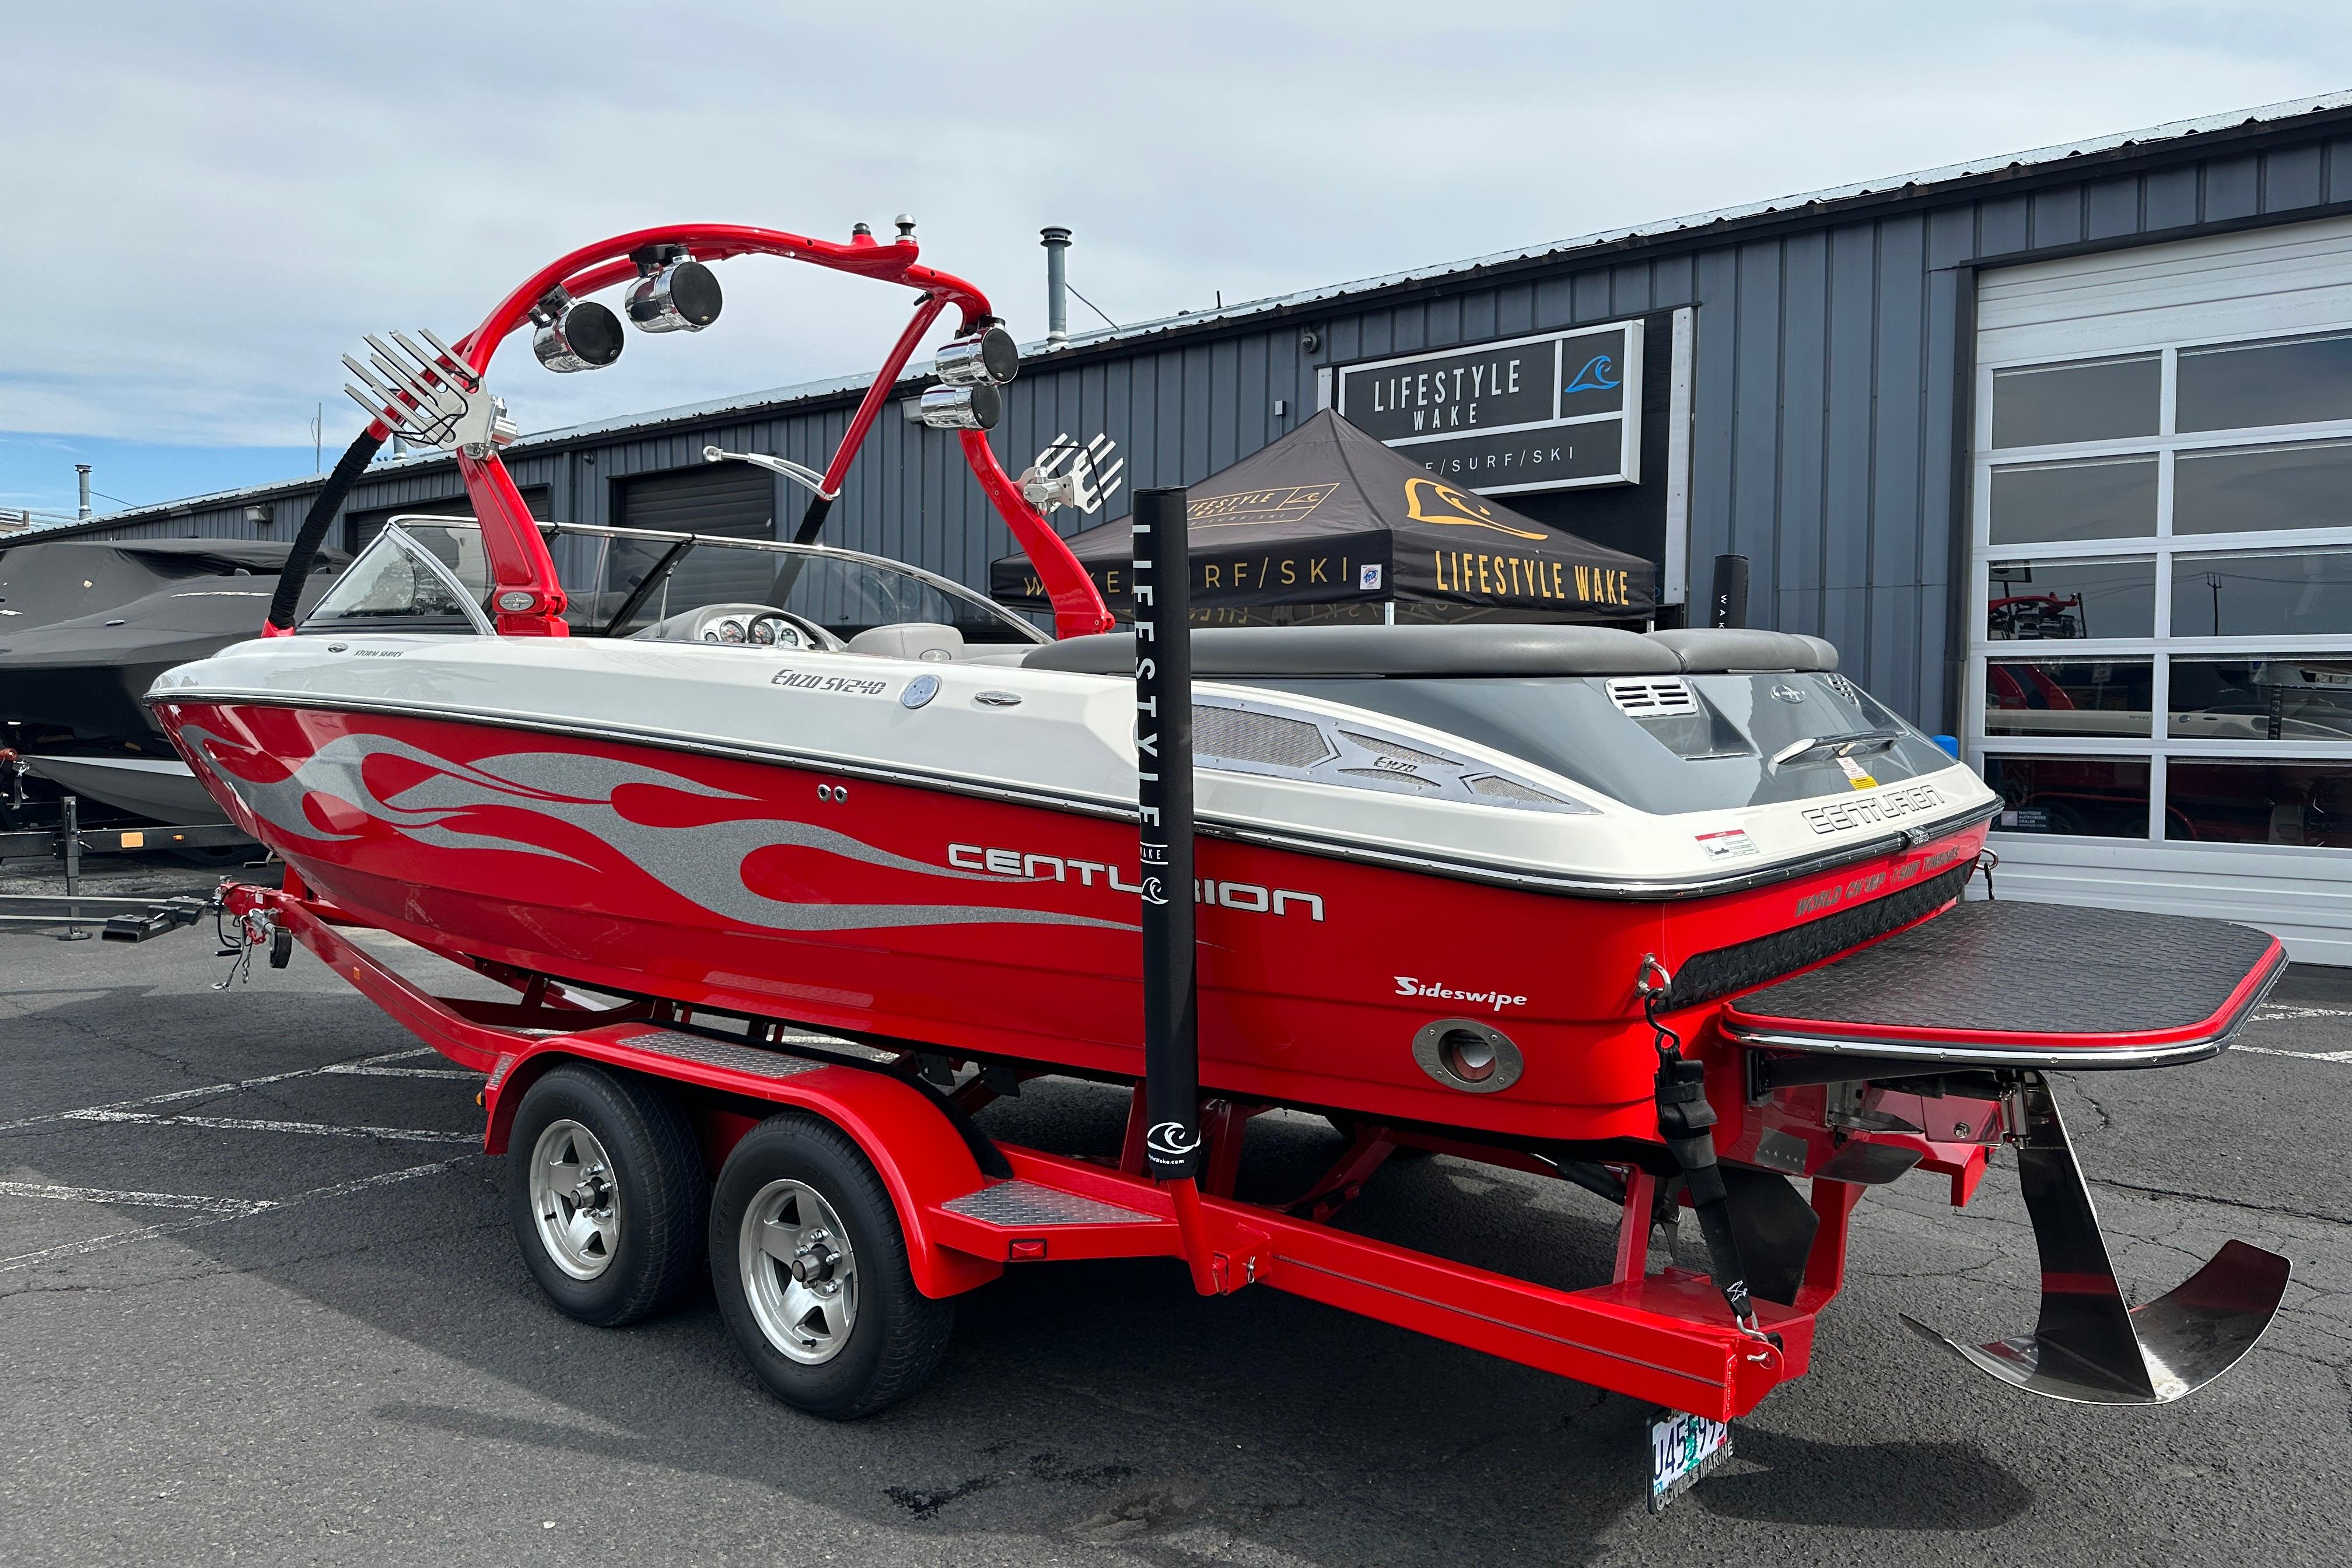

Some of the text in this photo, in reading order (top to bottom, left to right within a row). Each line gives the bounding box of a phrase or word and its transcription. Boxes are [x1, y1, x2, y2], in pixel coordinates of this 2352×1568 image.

[1374, 359, 1520, 412] LIFESTYLE
[1413, 403, 1477, 430] WAKE
[1435, 550, 1565, 600] LIFESTYLE
[1574, 565, 1630, 606] WAKE
[771, 669, 887, 695] ENZO SV240
[1132, 524, 1160, 827] LIFESTYLE
[1373, 757, 1418, 773] ENZO
[1801, 785, 1945, 834] CENTURION
[1139, 844, 1161, 860] AKE
[947, 842, 1325, 922] CENTUION
[1795, 885, 1842, 918] WORLD
[1393, 976, 1528, 1012] Sideswipe
[1656, 1437, 1734, 1511] OLIVER'S MARINE
